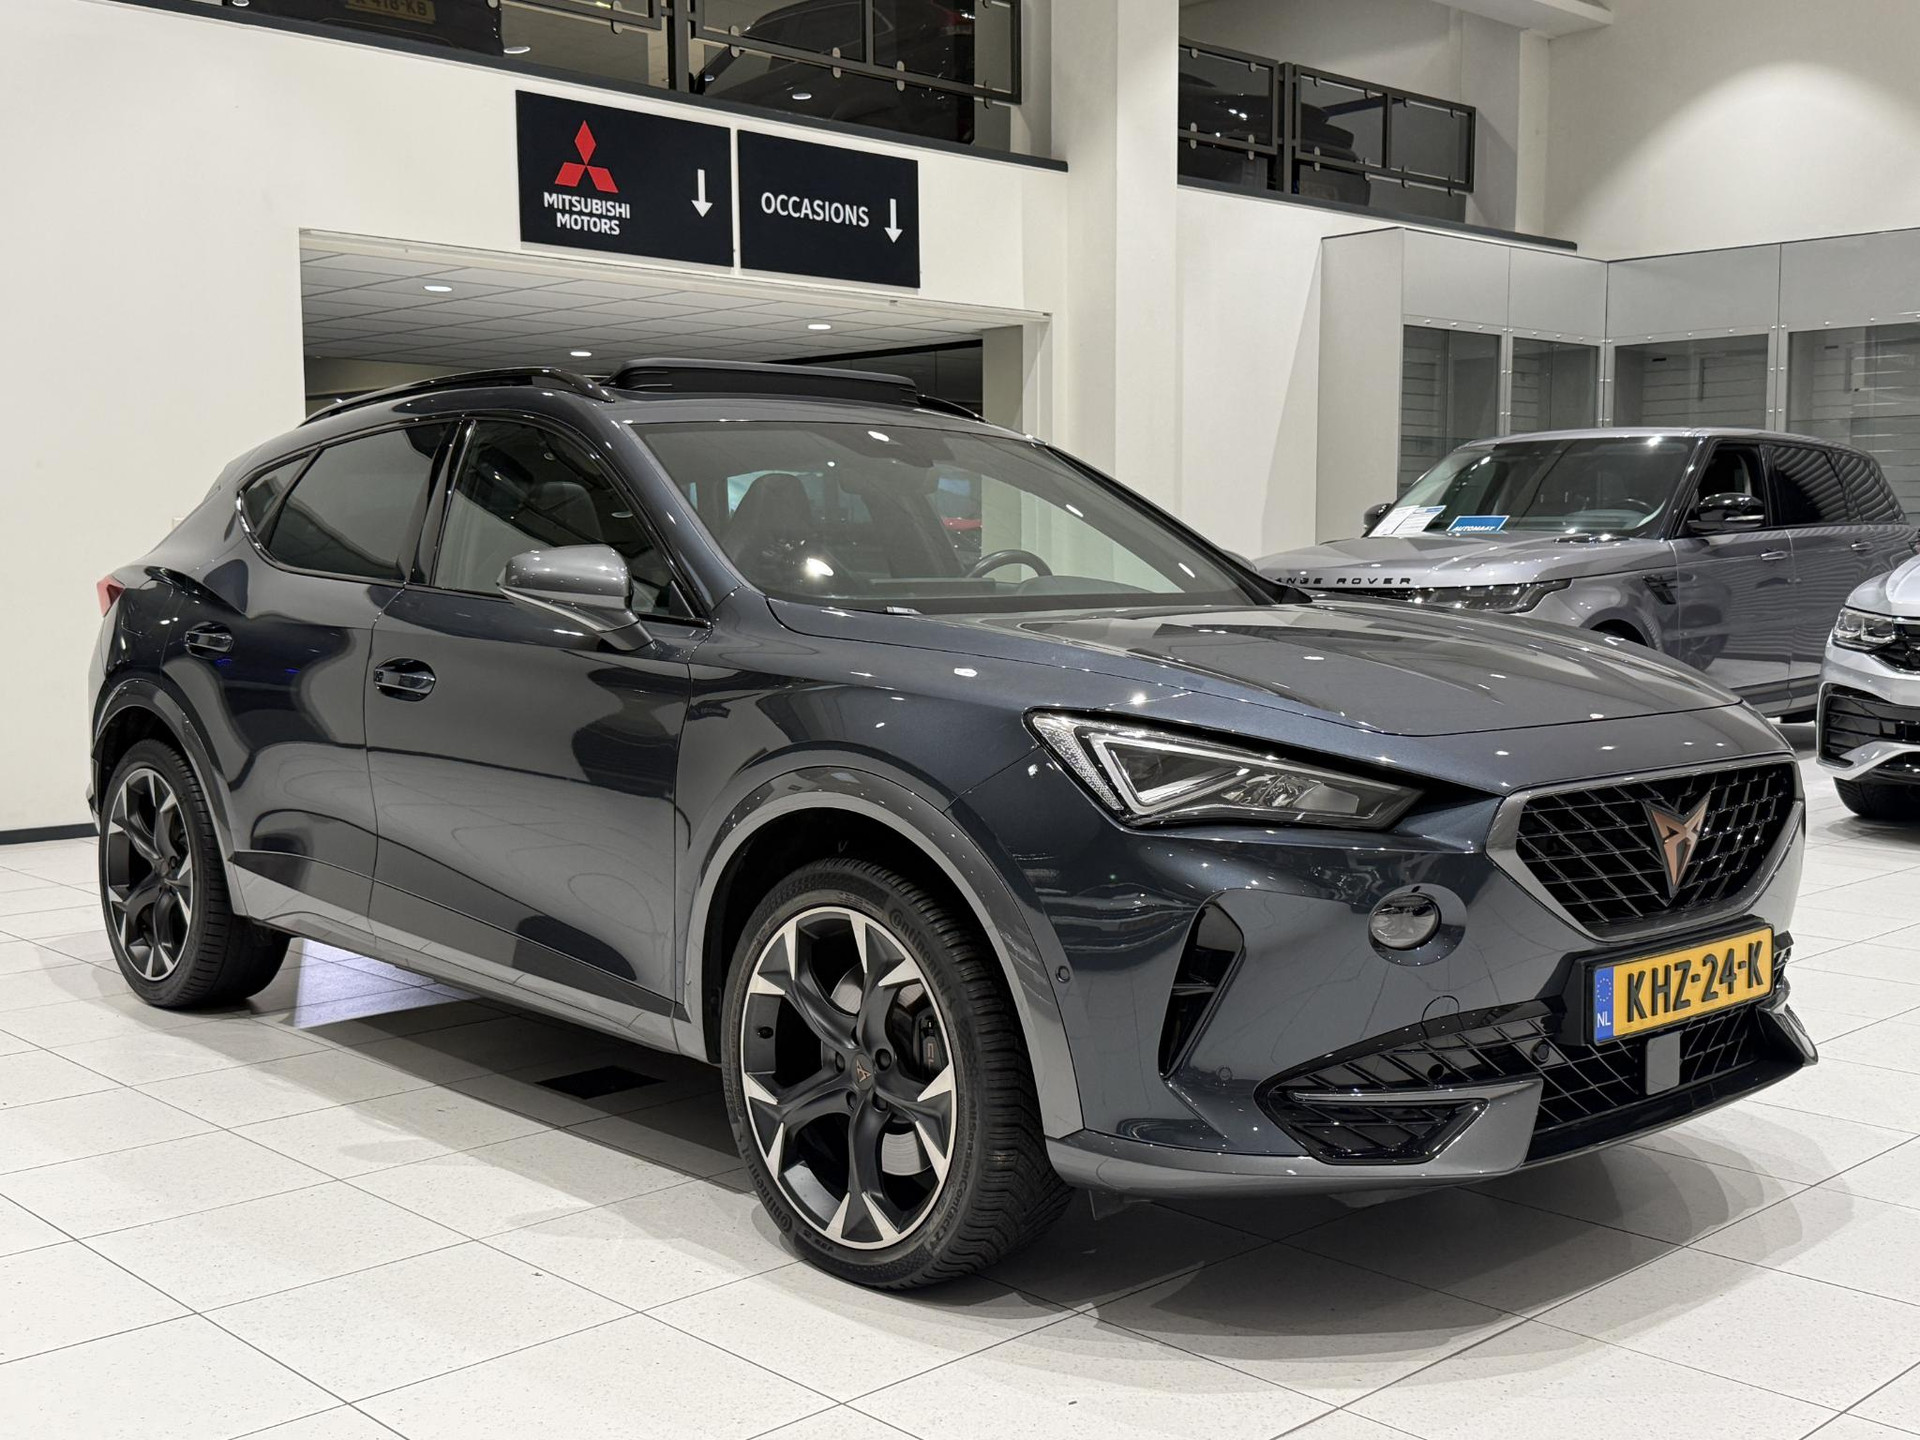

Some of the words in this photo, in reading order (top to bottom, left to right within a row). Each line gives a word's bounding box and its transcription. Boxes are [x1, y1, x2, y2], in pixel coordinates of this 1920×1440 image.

[543, 191, 630, 219] MITSUBISHI
[761, 191, 869, 228] OCCASIONS
[556, 212, 620, 236] MOTORS
[1336, 577, 1411, 585] ROVER
[1627, 940, 1764, 1023] KHZ-24-K
[1597, 1011, 1611, 1028] NL
